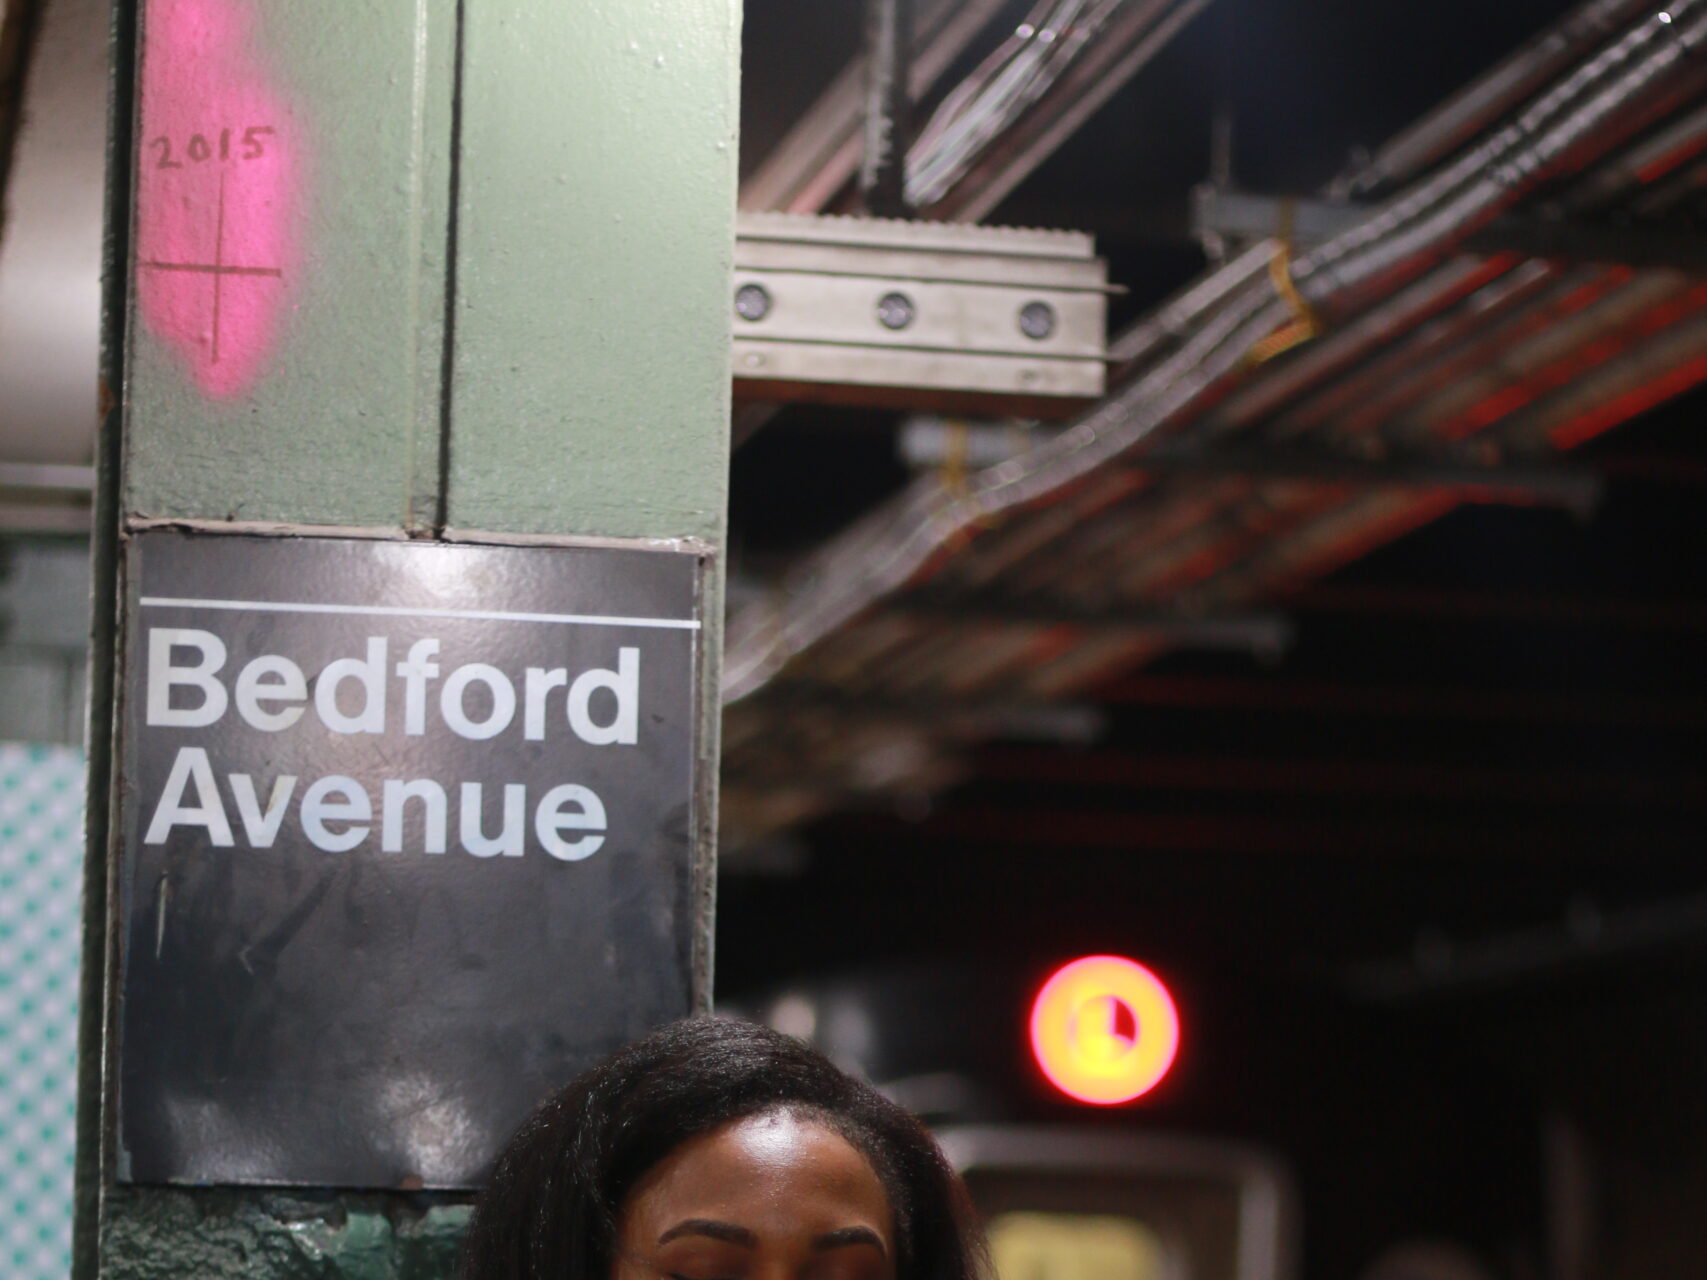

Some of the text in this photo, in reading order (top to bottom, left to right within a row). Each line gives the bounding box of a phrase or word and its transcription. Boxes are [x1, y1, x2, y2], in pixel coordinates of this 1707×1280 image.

[151, 126, 275, 169] 2015
[146, 627, 641, 746] Bedford
[143, 746, 608, 862] Avenue
